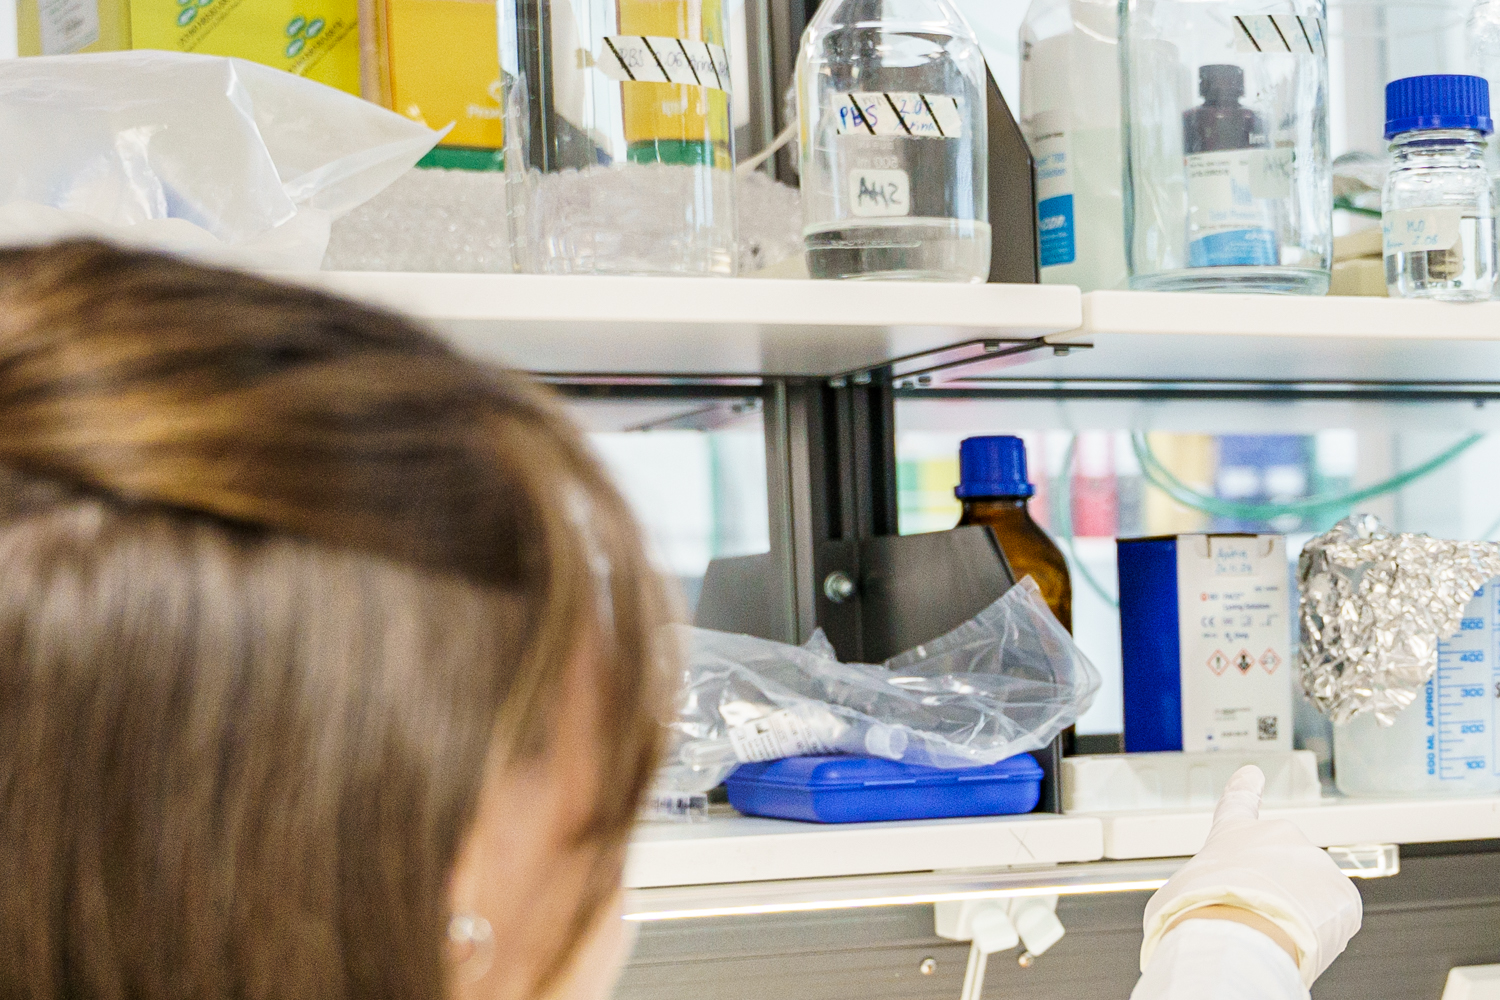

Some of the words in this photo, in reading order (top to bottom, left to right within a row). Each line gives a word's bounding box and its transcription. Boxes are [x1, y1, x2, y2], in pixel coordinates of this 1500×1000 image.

[839, 103, 879, 130] PBS
[1459, 653, 1485, 663] 400
[1461, 688, 1485, 698] 300
[1461, 724, 1486, 734] 200
[1427, 752, 1436, 776] 600
[1465, 761, 1486, 770] 100
